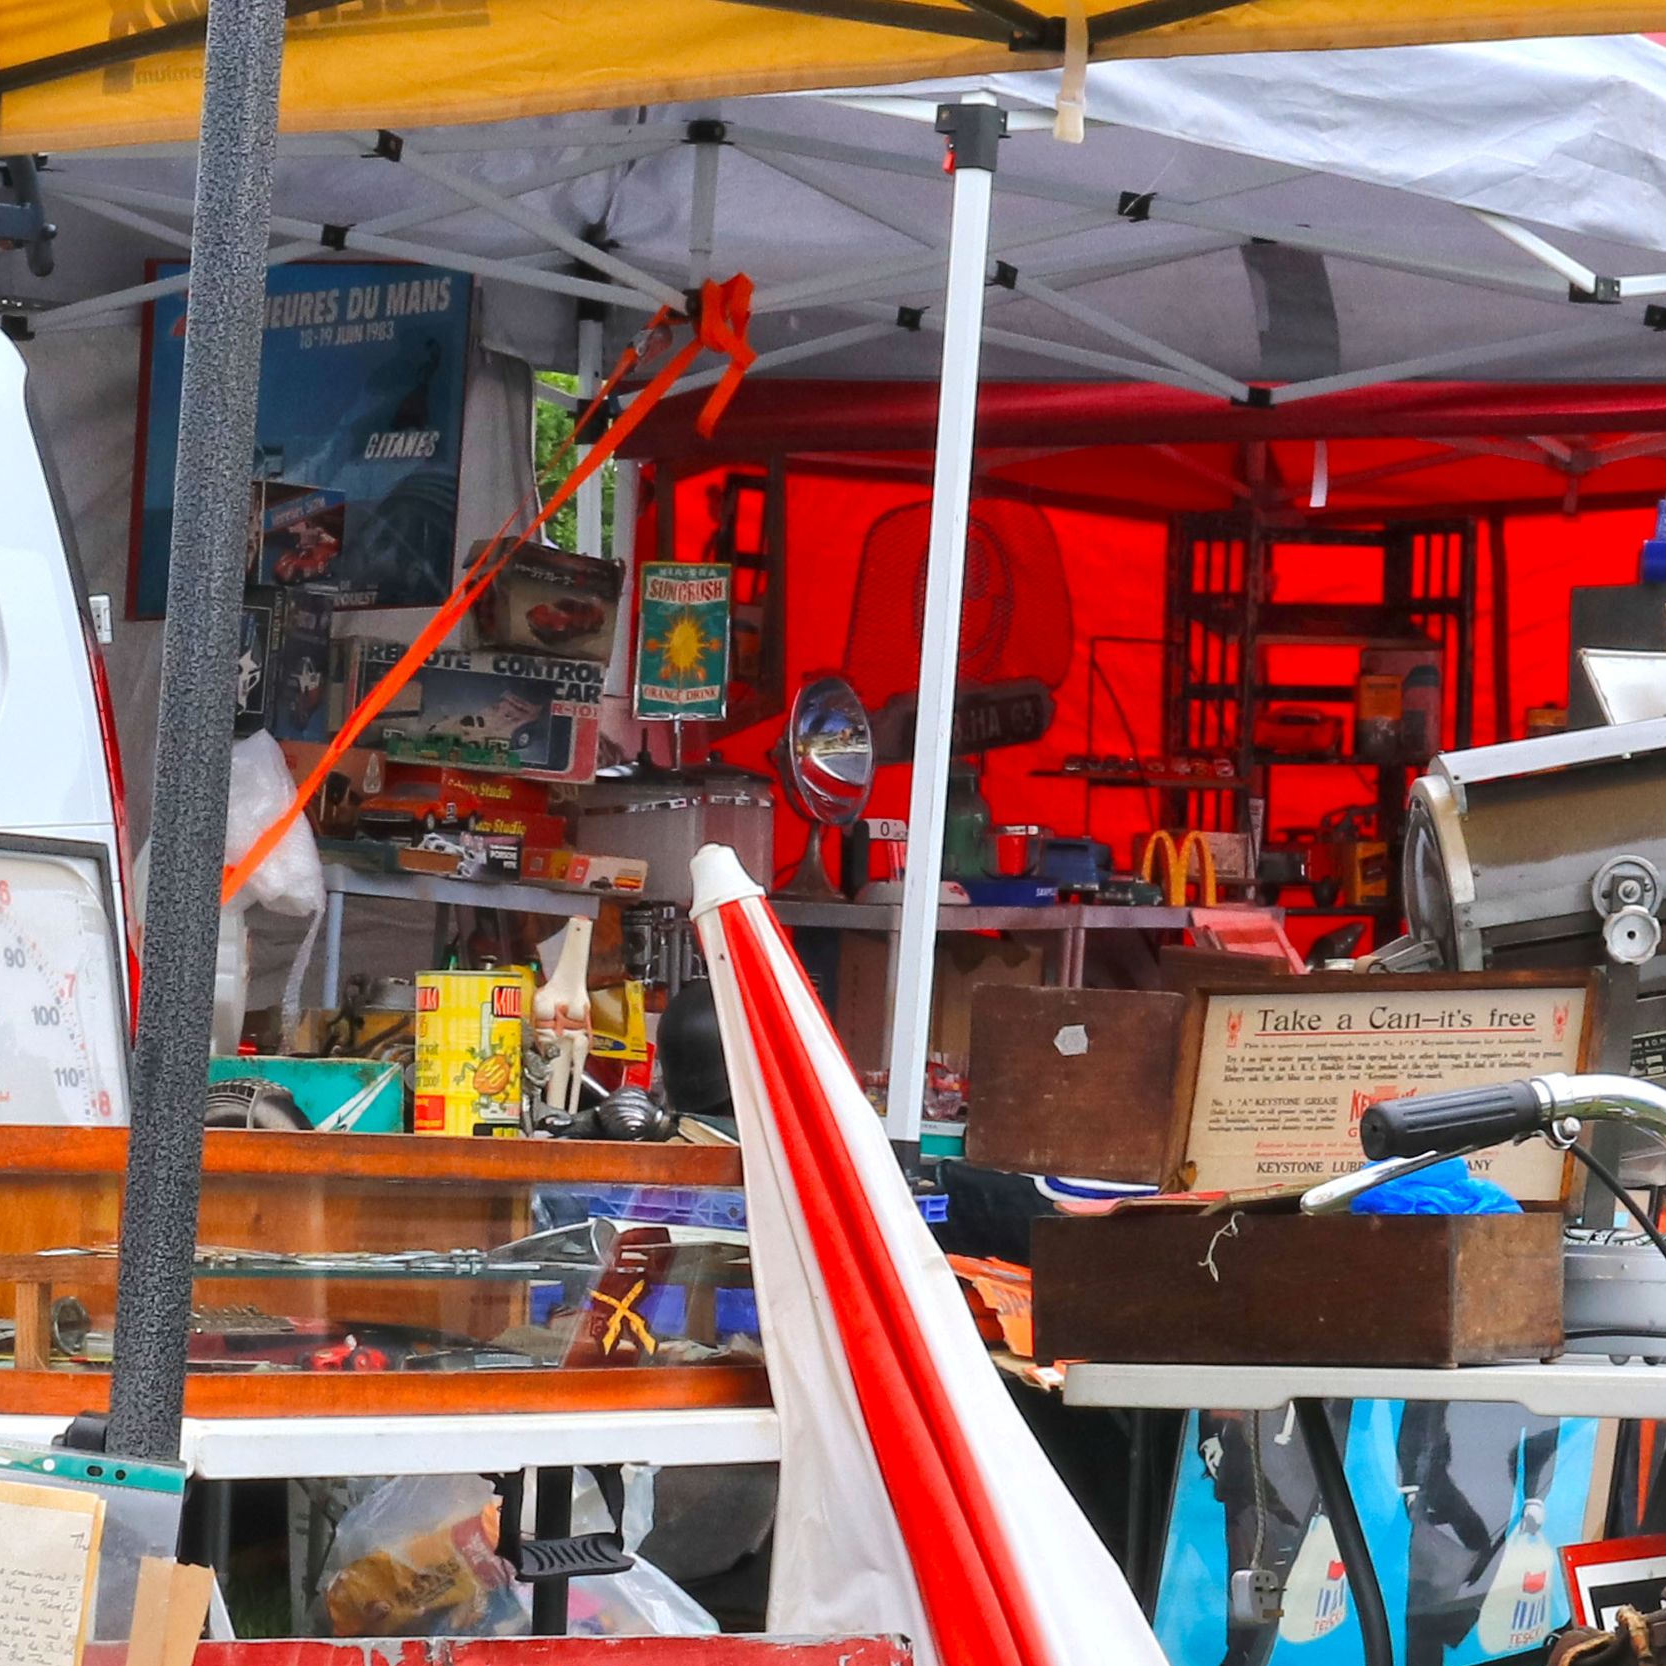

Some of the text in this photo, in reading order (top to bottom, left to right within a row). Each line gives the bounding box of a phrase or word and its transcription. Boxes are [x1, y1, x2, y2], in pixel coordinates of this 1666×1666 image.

[346, 285, 381, 320] DU
[385, 277, 453, 315] MANS
[334, 324, 364, 346] JUIN
[365, 431, 440, 460] GITANES
[649, 578, 723, 603] SUNCRUSH
[367, 642, 604, 684] REOTE CONTROL
[552, 682, 603, 704] CAR
[3, 947, 26, 969] 90
[64, 974, 77, 999] 7
[33, 1005, 61, 1028] 100
[1257, 1008, 1322, 1032] Take
[1336, 1013, 1353, 1032] a
[1490, 1008, 1536, 1027] free
[54, 1066, 80, 1088] 110
[97, 1090, 112, 1118] 8
[1254, 1095, 1339, 1108] KEYSTONE GREASE
[1256, 1160, 1324, 1174] KEYSTONE
